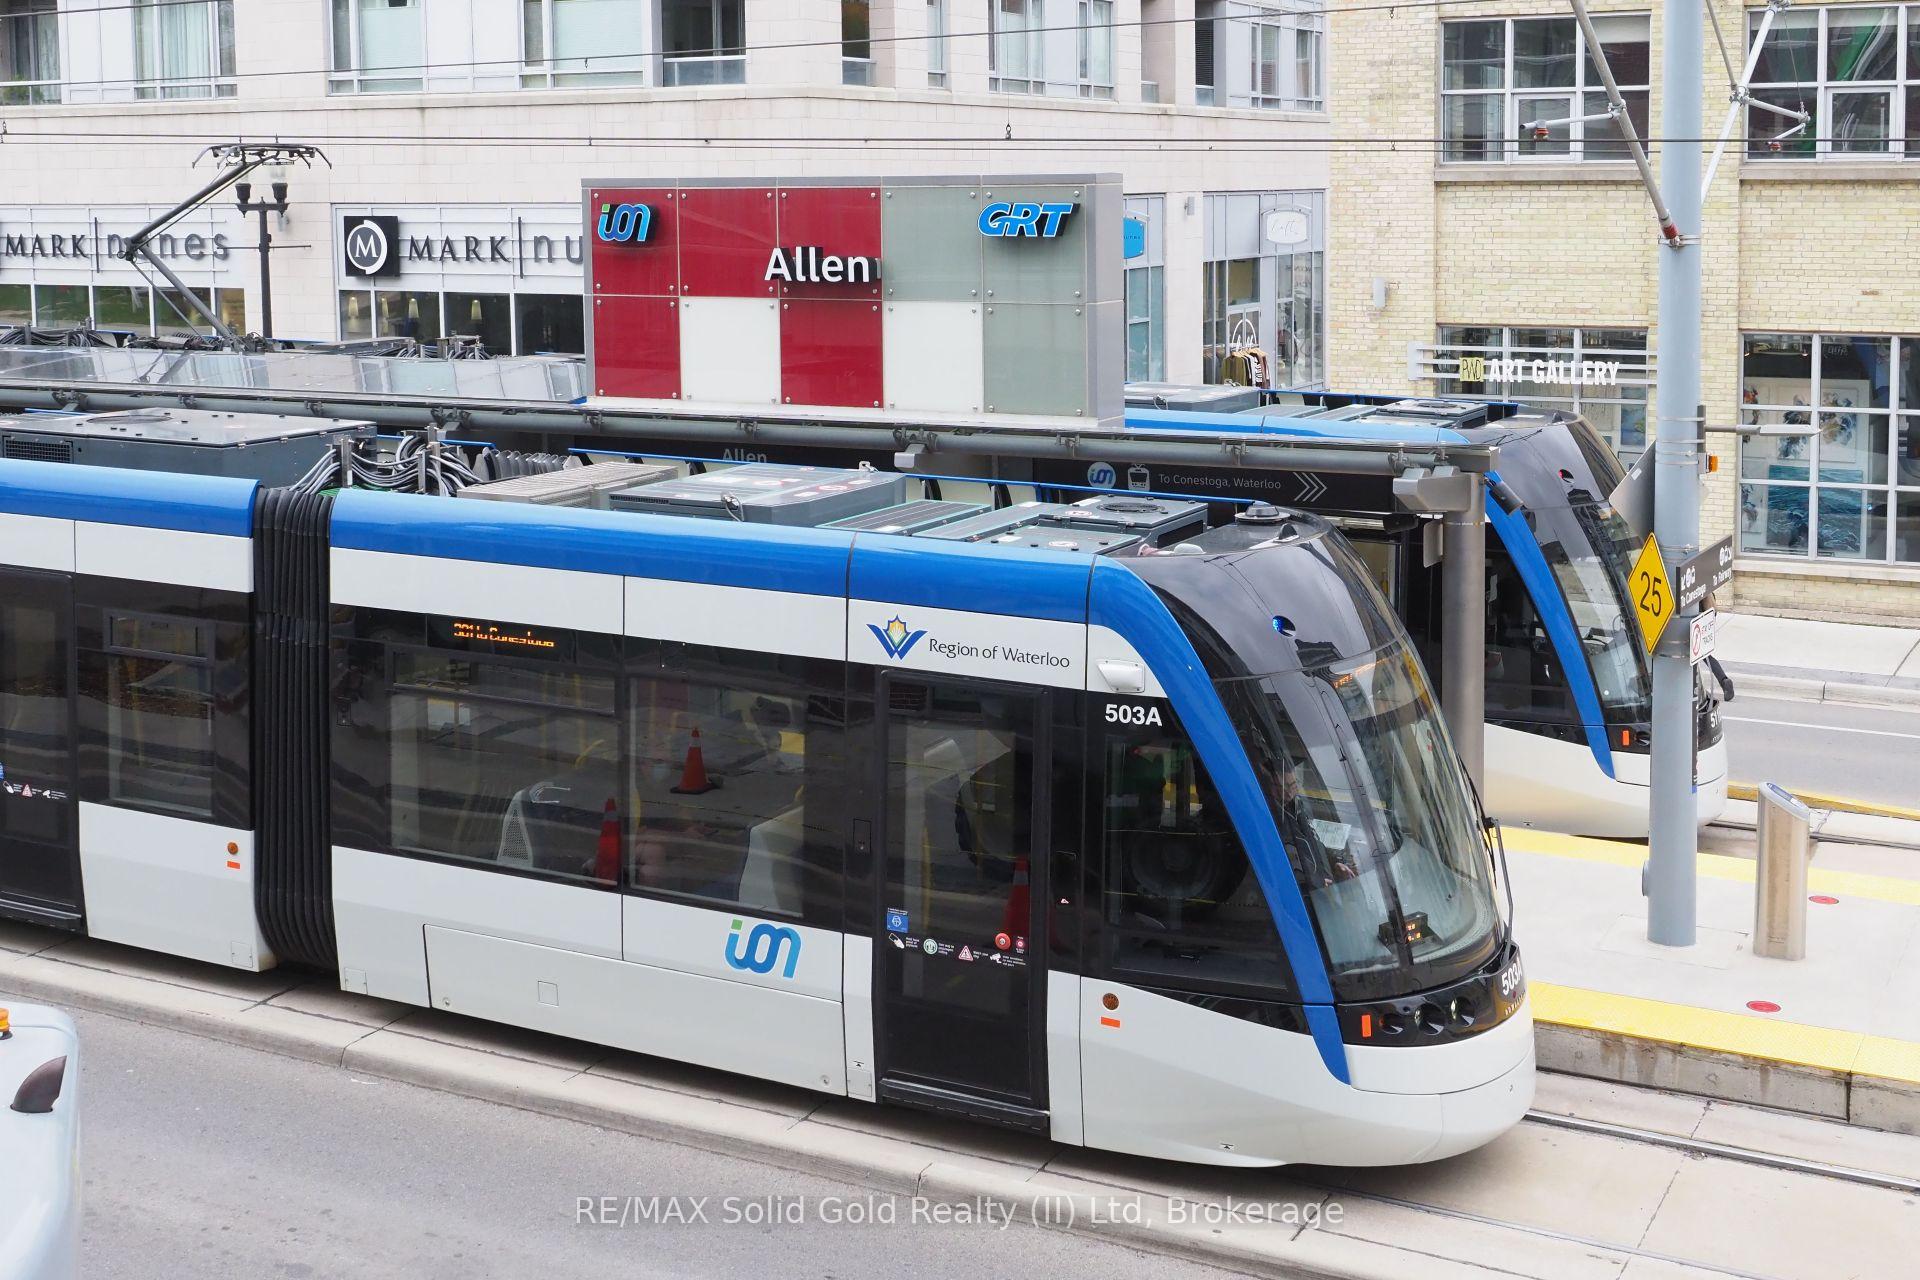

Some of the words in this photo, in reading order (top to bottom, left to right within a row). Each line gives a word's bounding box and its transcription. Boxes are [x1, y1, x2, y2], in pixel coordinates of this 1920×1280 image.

[977, 202, 1074, 238] GRT
[5, 233, 90, 259] MARK
[107, 232, 230, 260] nnes
[408, 235, 511, 263] MARK
[764, 246, 870, 283] Allen
[1489, 358, 1525, 383] ART
[1532, 359, 1619, 386] GALLERY
[722, 448, 767, 463] Allen
[1159, 474, 1170, 484] To
[1173, 474, 1231, 489] Conestoga,
[1233, 477, 1282, 489] Waterloo
[1640, 570, 1662, 617] 25
[929, 638, 979, 659] Region
[982, 645, 998, 660] of
[1002, 646, 1070, 668] Waterloo
[1104, 703, 1163, 727] 503A
